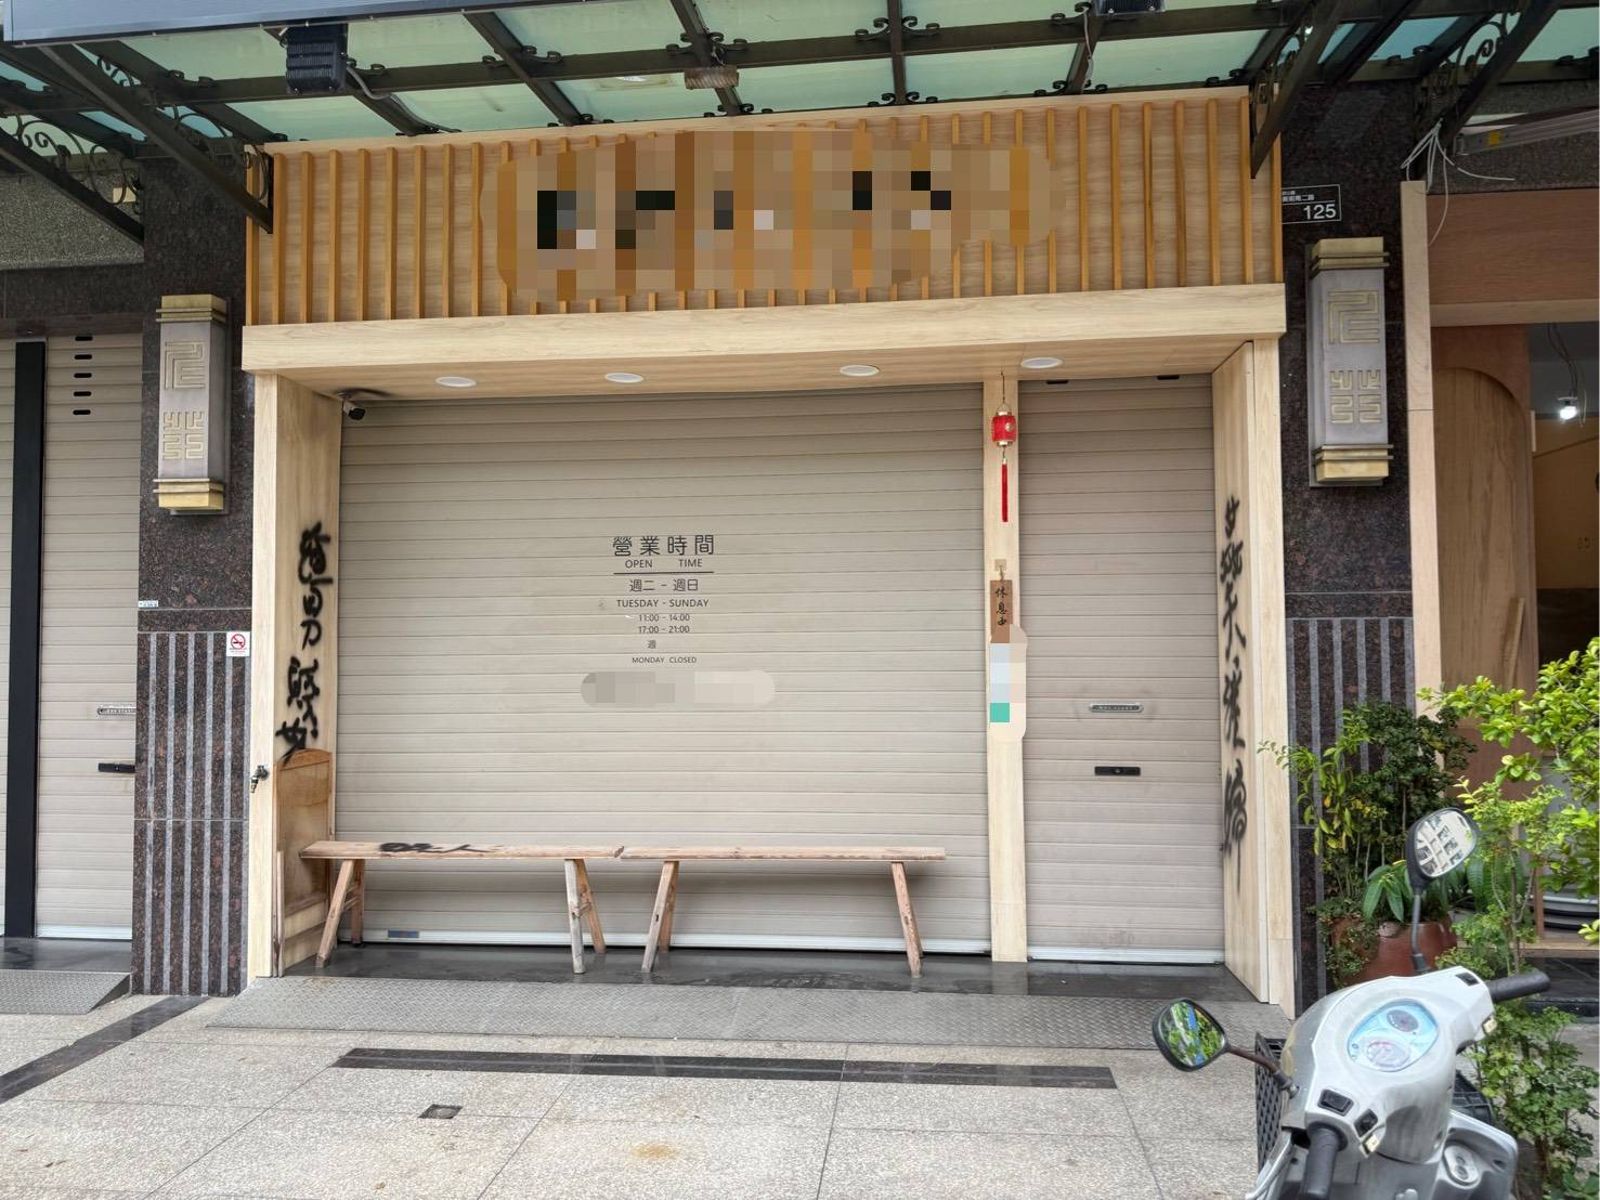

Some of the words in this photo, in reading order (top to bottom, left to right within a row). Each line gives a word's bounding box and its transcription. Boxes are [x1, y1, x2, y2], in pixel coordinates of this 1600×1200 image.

[1303, 203, 1337, 220] 125
[612, 534, 715, 557] 營業時間
[624, 559, 653, 569] OPEN
[678, 558, 703, 568] TIME
[629, 578, 656, 593] 週二
[672, 578, 699, 592] 週日
[616, 599, 659, 608] TUESDAY
[668, 598, 709, 608] SUNDAY
[638, 614, 660, 622] 11:00
[669, 613, 691, 622] 14:00
[638, 625, 660, 634] 17:00
[668, 625, 691, 634] 21:00
[631, 656, 665, 664] MONDAY
[668, 656, 698, 664] CLOSED
